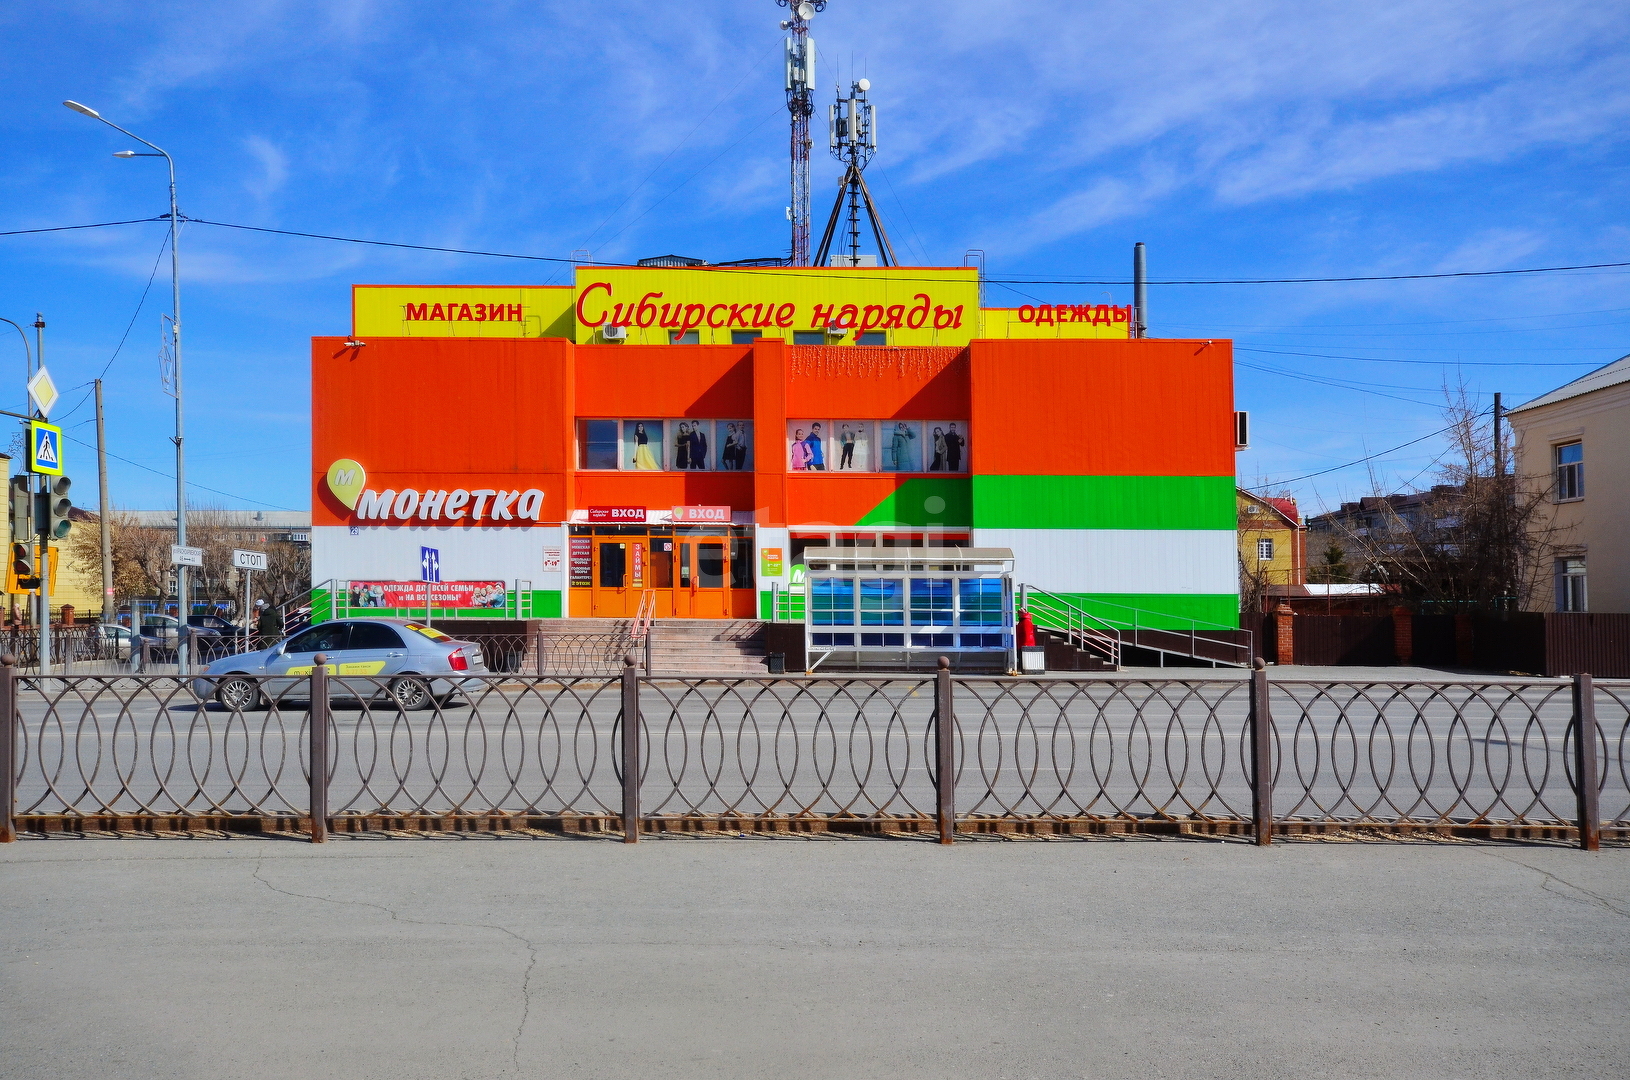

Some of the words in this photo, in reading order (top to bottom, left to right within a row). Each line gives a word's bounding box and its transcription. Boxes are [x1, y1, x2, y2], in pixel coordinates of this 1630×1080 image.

[405, 302, 523, 322] МАГАЗИН
[576, 282, 795, 340] Сибирские
[810, 293, 965, 340] наряды
[1018, 304, 1131, 326] ОДЕЖДЫ
[611, 508, 645, 519] ВХОД
[688, 509, 725, 520] ВХОД
[240, 553, 262, 566] СТОП
[432, 583, 449, 592] ВСЕЙ
